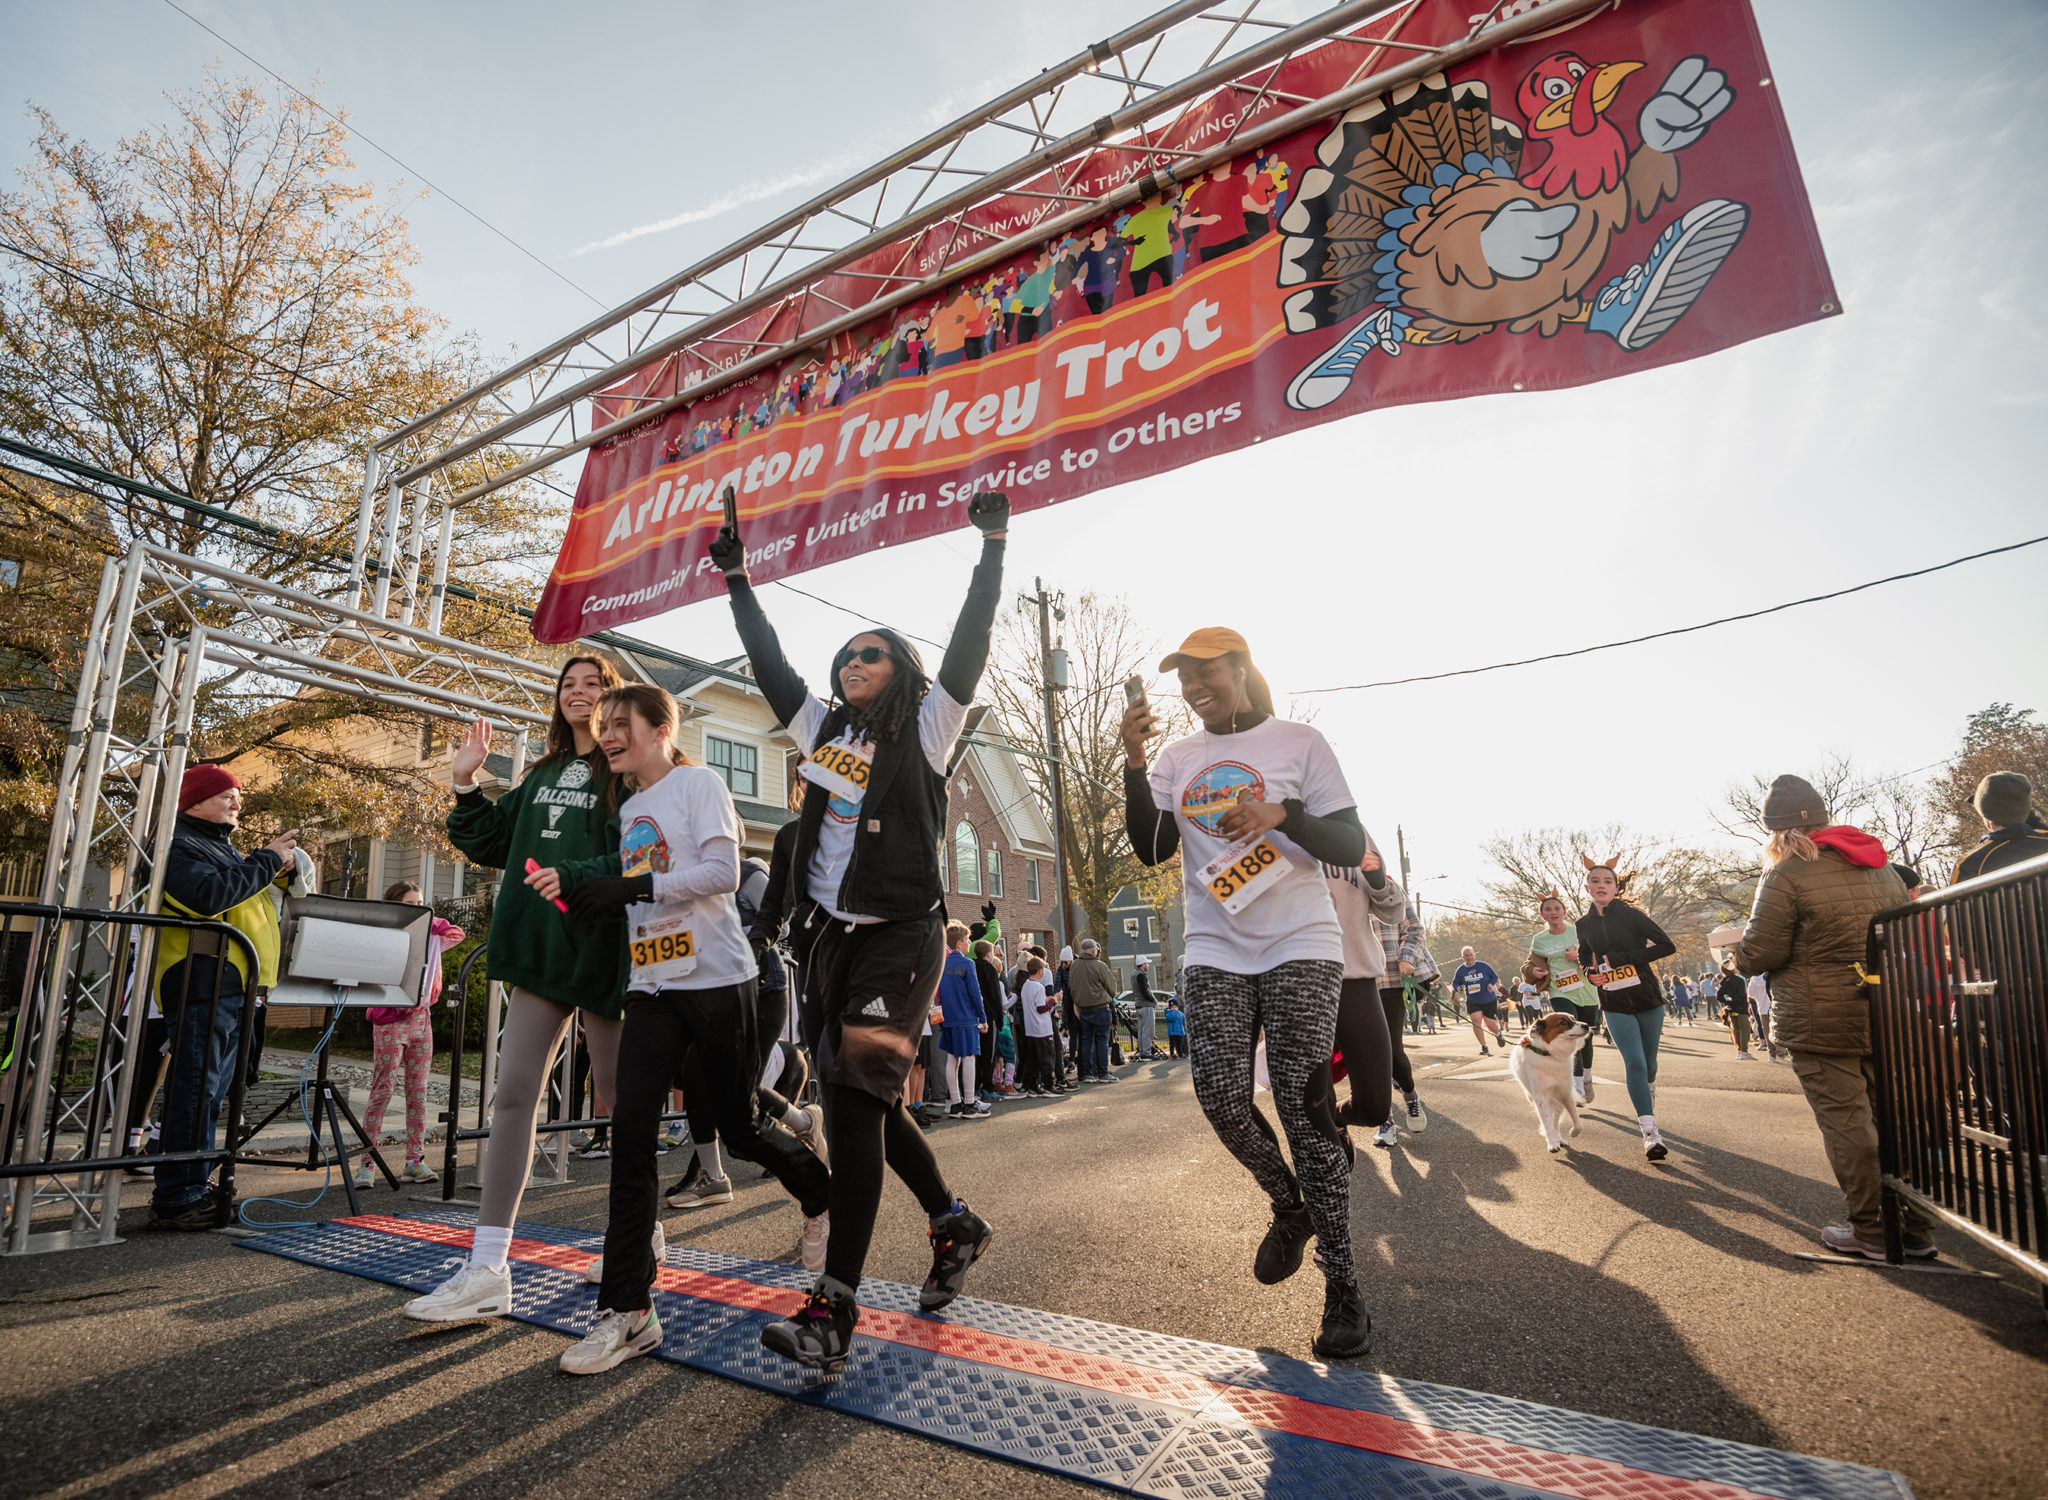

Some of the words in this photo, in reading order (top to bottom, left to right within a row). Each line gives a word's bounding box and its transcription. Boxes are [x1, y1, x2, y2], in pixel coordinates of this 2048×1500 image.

[919, 252, 936, 272] 5K
[938, 235, 968, 261] FUN
[1064, 180, 1090, 198] ON
[1095, 113, 1237, 191] THANKSGIVING
[1241, 89, 1282, 120] DAY
[717, 374, 760, 397] ARLINGTON
[602, 440, 825, 549] Arlington
[835, 377, 1041, 466] Turkey
[1055, 297, 1223, 399] Trot
[581, 564, 692, 615] Community
[805, 493, 888, 546] United
[897, 491, 926, 514] in
[937, 457, 1051, 507] Service
[1061, 447, 1099, 474] to
[1107, 401, 1243, 454] Others
[813, 744, 870, 785] 3185
[532, 785, 599, 810] FALCONS
[1213, 844, 1276, 898] 3186
[634, 932, 690, 966] 3195
[1555, 975, 1580, 988] 3578
[1602, 965, 1634, 984] 3750
[861, 1007, 890, 1019] adidas
